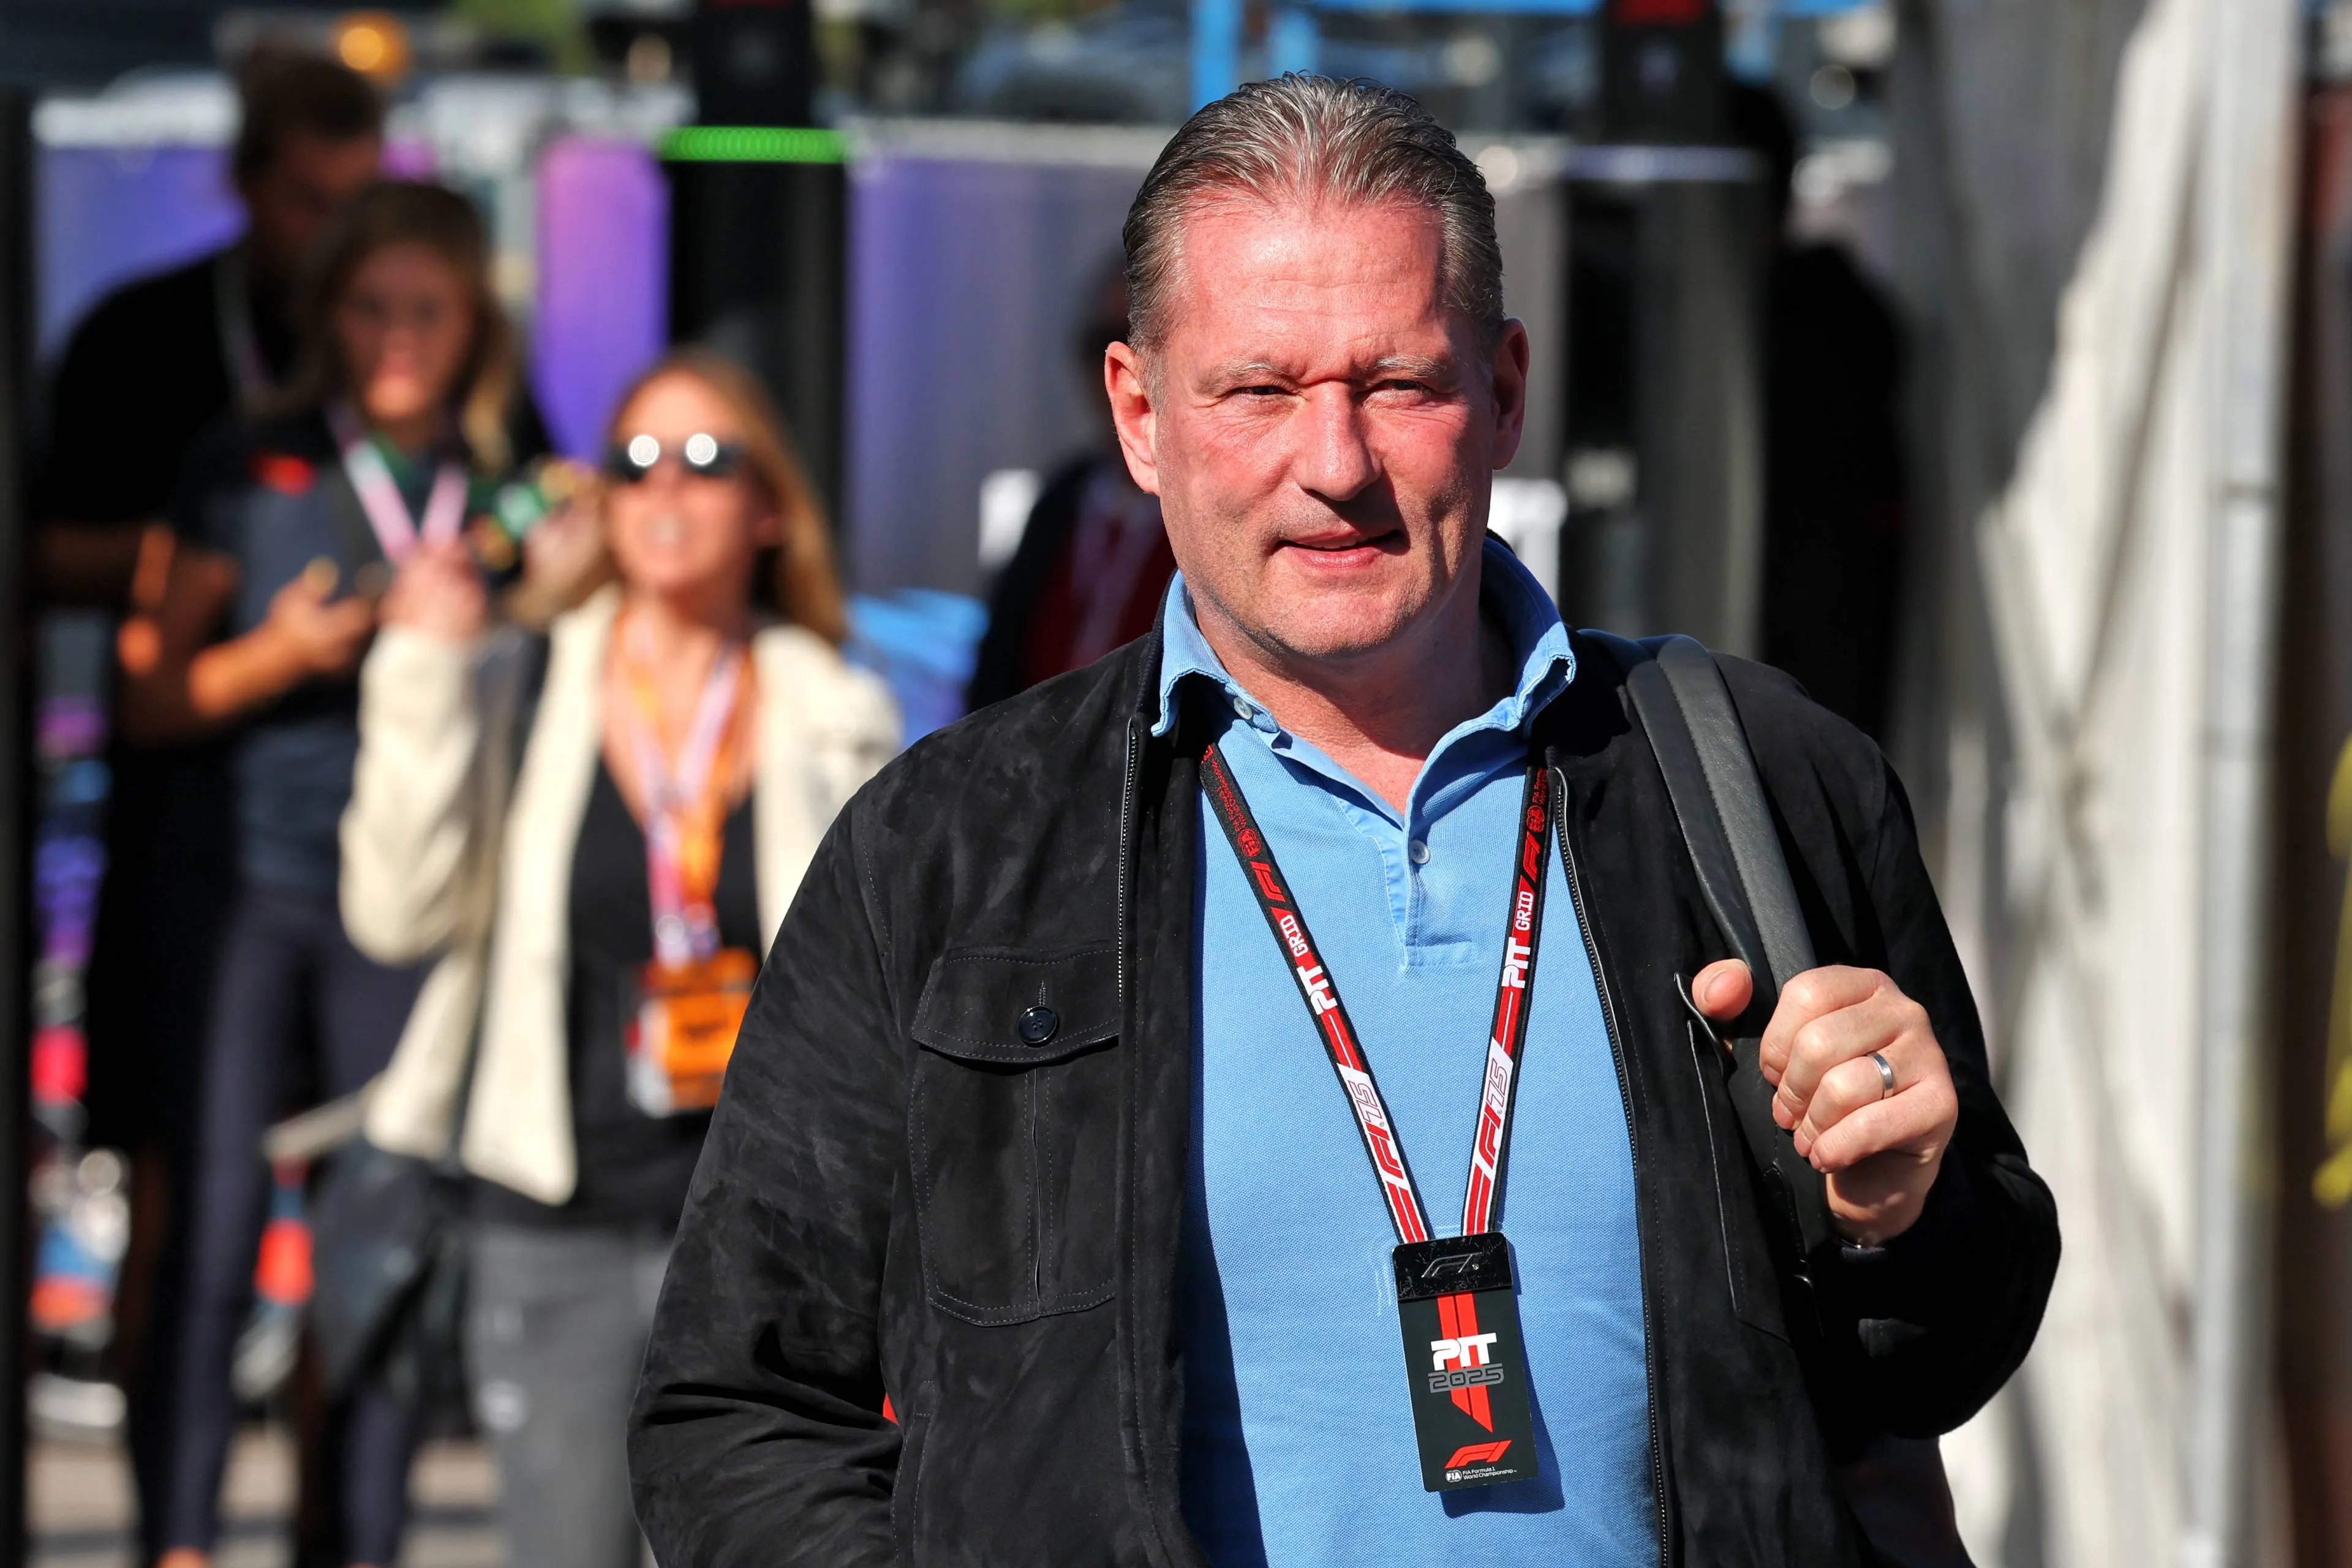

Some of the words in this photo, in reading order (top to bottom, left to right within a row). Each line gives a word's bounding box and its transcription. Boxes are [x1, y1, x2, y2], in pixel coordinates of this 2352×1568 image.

[1523, 831, 1540, 883] F1
[1250, 861, 1286, 902] F1
[1515, 891, 1534, 931] GRID
[1280, 914, 1309, 957] GRID
[1501, 937, 1531, 989] PIT
[1297, 965, 1338, 1016] PIT
[1431, 1332, 1497, 1371] PIT
[1428, 1363, 1504, 1393] 2025
[1444, 1439, 1512, 1468] F1
[1479, 1469, 1513, 1478] Championship
[1446, 1472, 1461, 1481] FIA
